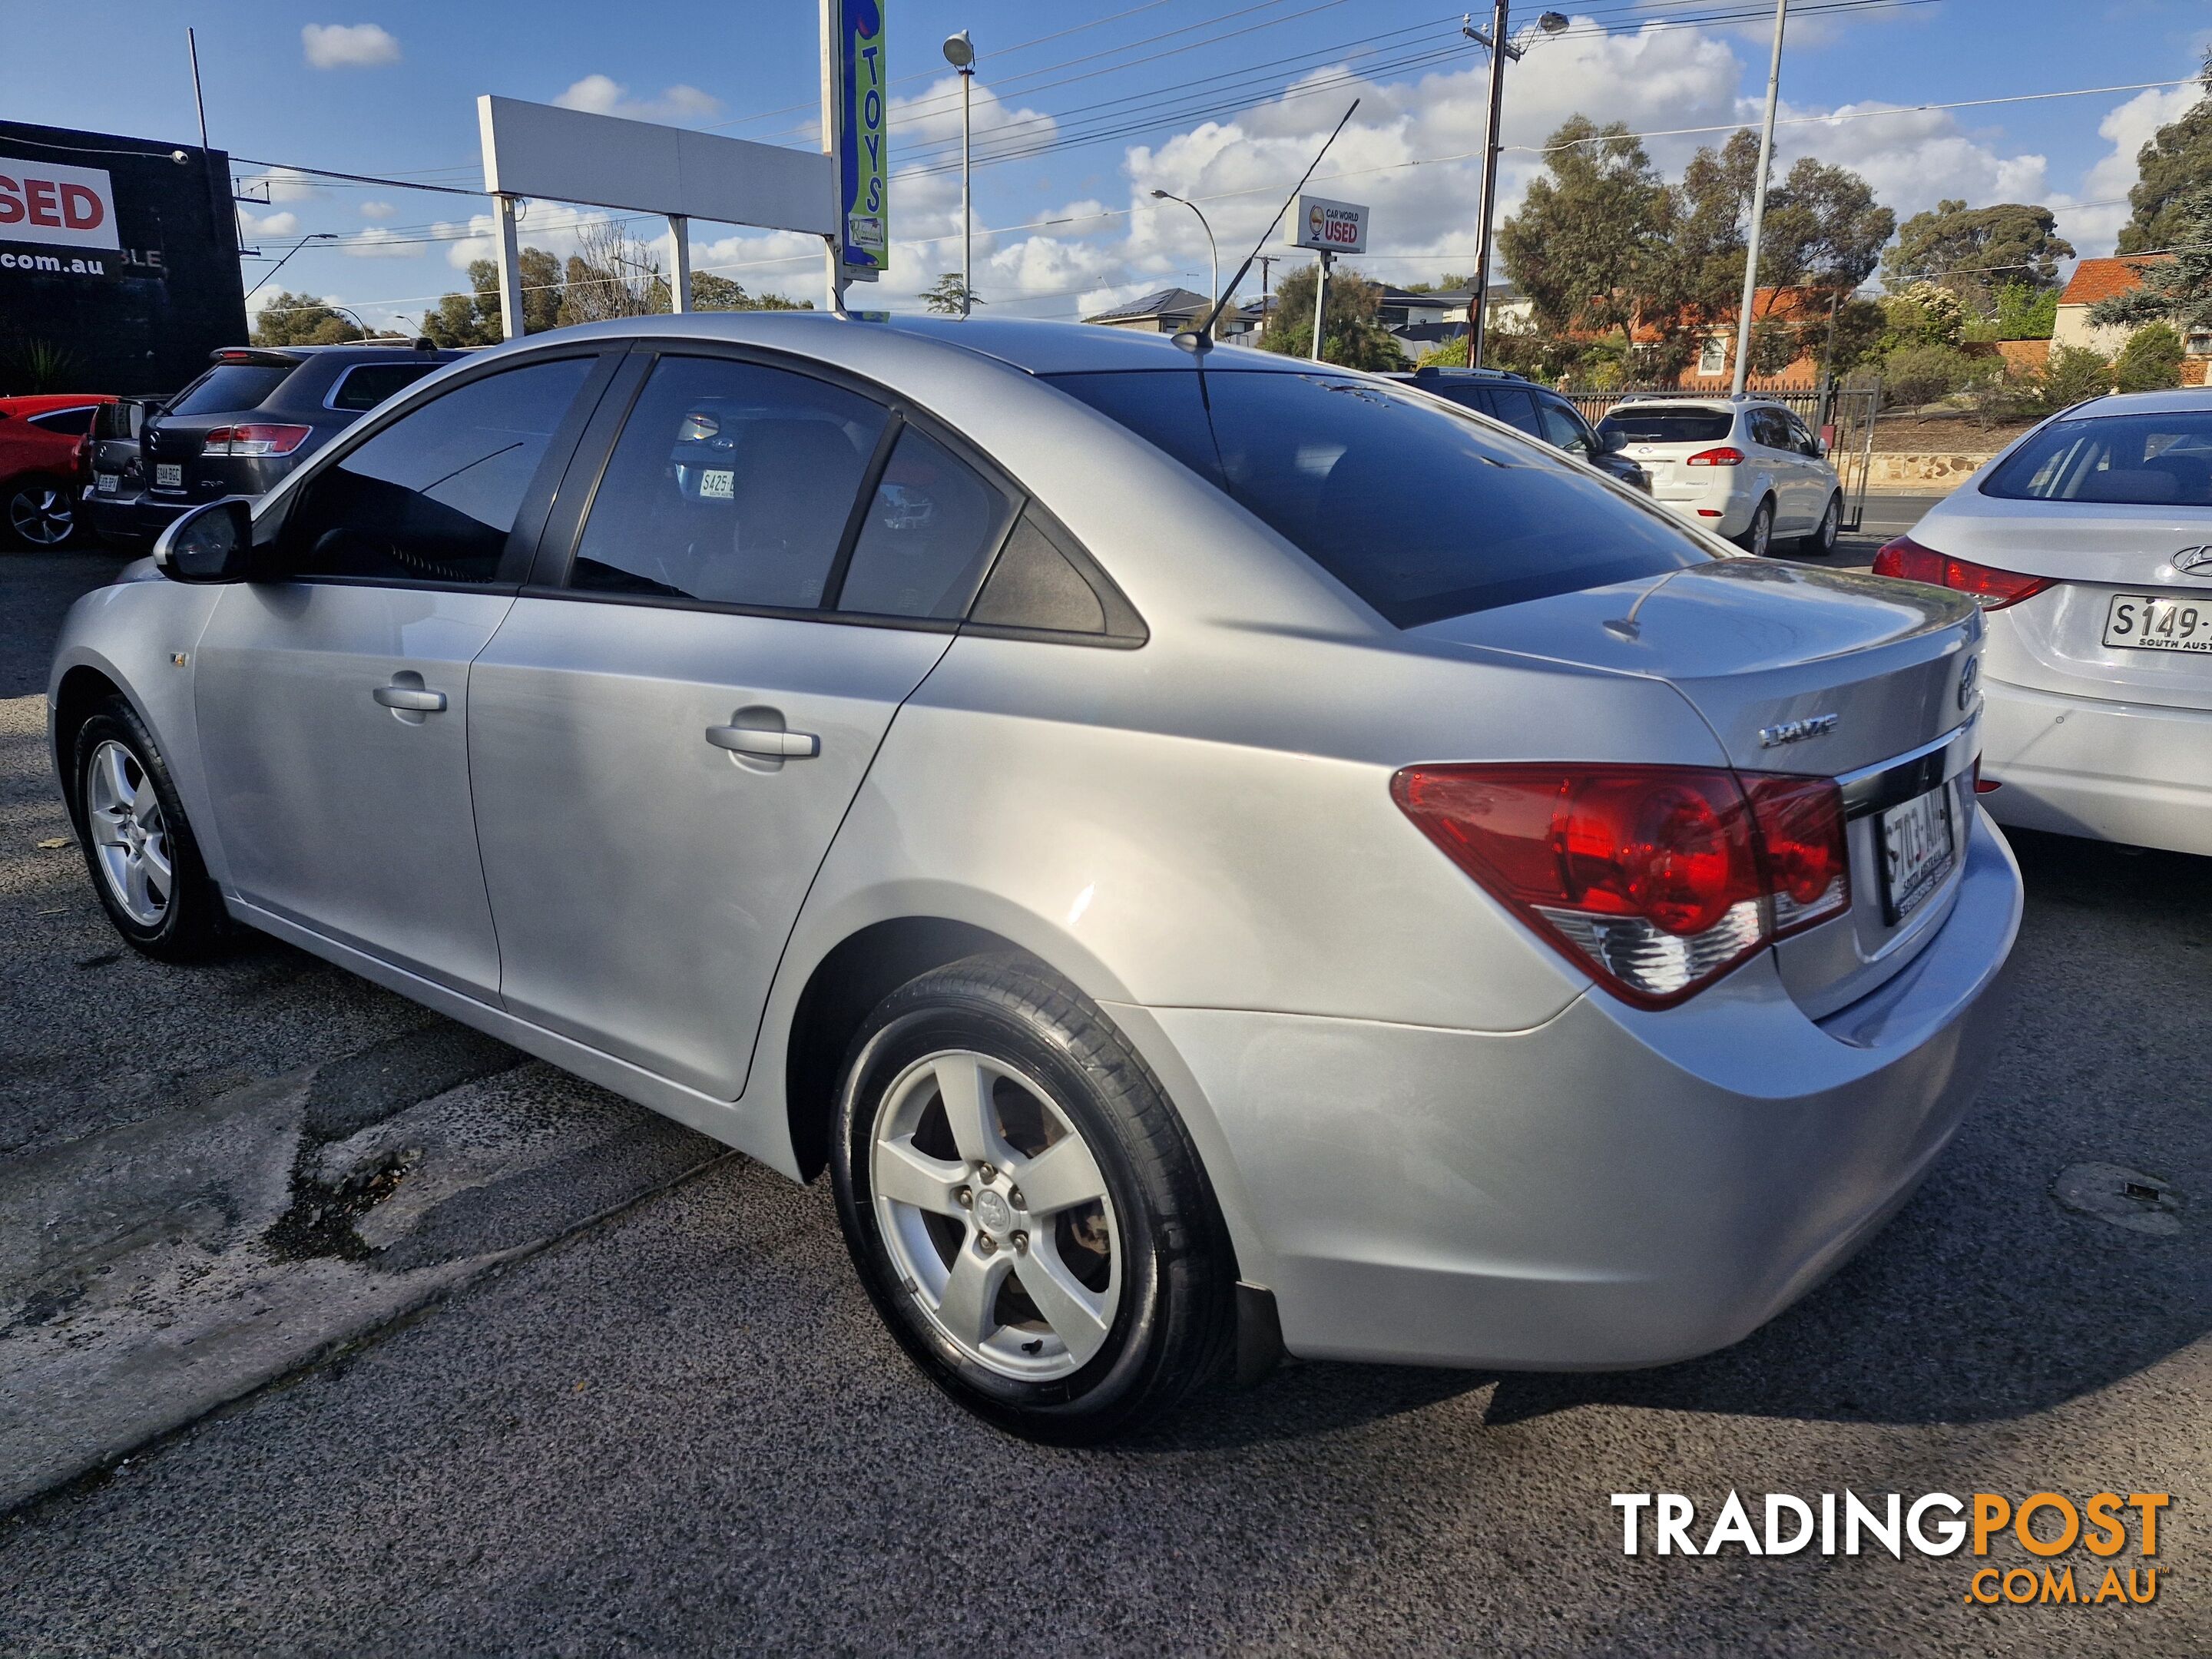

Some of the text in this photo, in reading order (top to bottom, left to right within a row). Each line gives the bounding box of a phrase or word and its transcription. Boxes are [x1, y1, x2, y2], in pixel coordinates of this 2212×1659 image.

[862, 45, 882, 213] TOYS
[1326, 209, 1359, 222] CAR WORLD
[1325, 220, 1357, 243] USED
[2113, 604, 2212, 638] S149-
[2139, 638, 2179, 648] SOUTH
